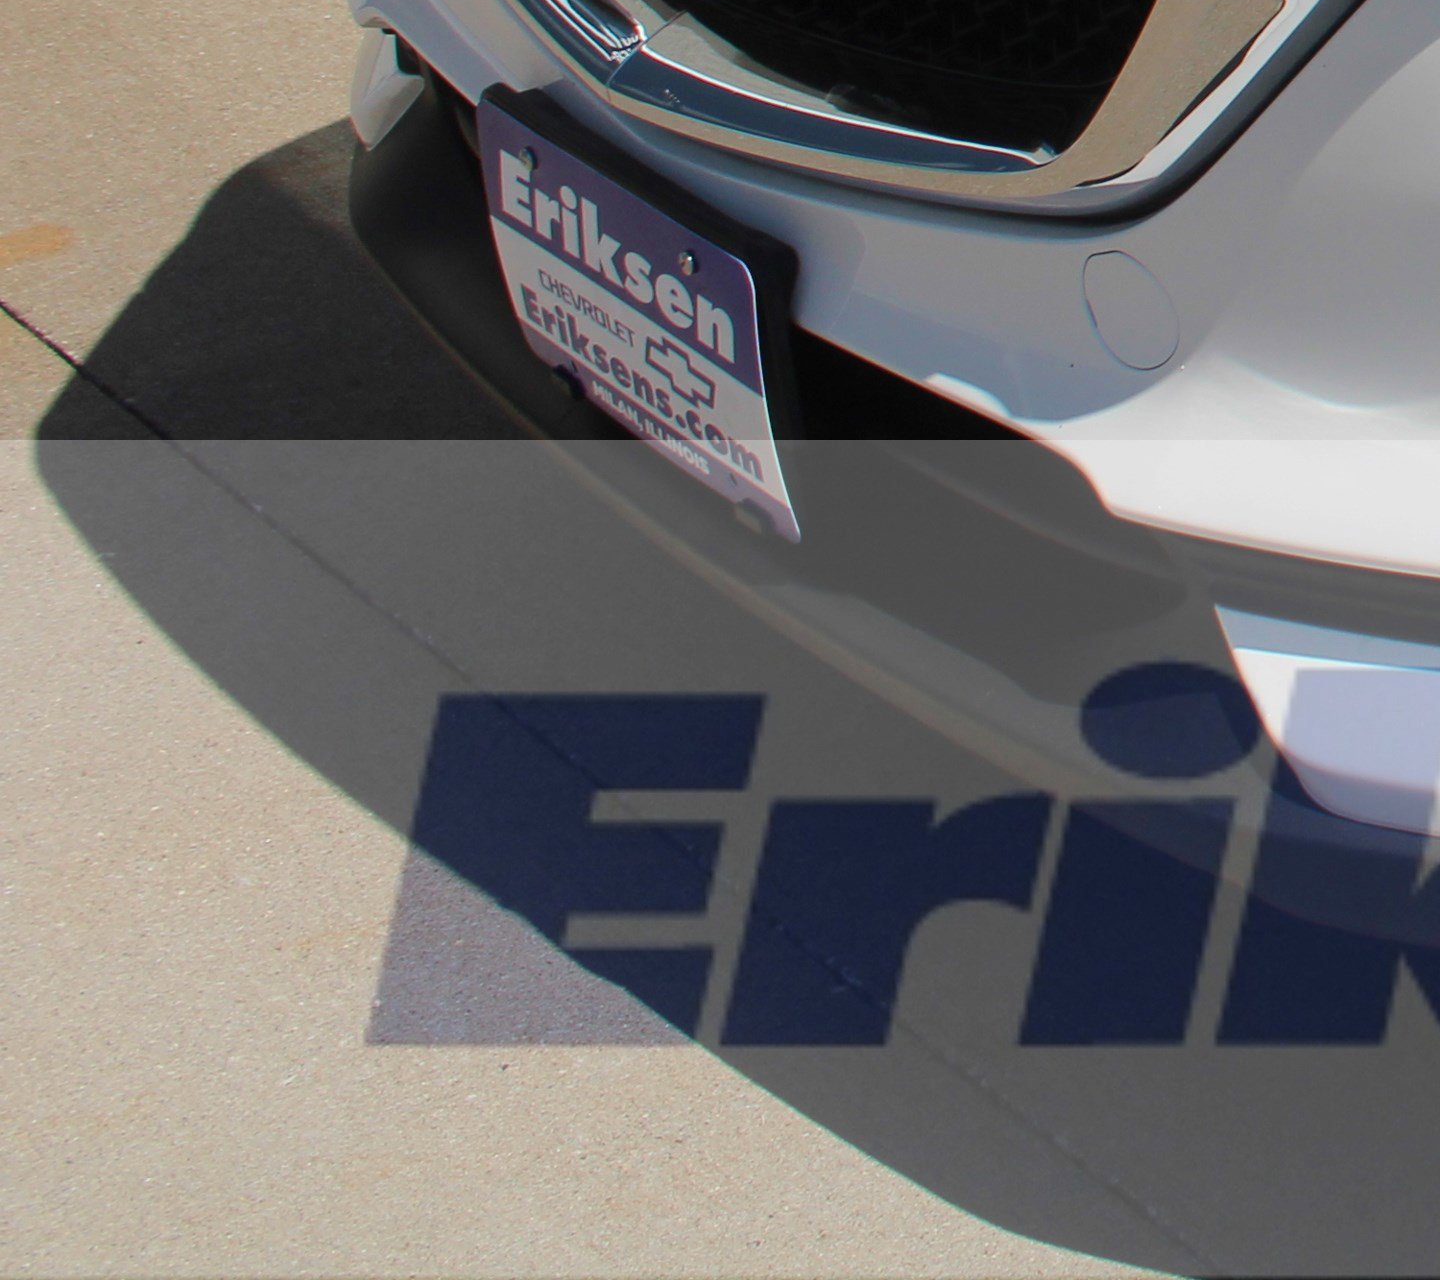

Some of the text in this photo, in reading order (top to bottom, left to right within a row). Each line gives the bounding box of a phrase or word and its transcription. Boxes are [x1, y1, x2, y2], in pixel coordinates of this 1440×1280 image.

[499, 148, 736, 365] Eriksen
[537, 269, 636, 348] CHEVROLET
[520, 282, 765, 483] Eriksens.com
